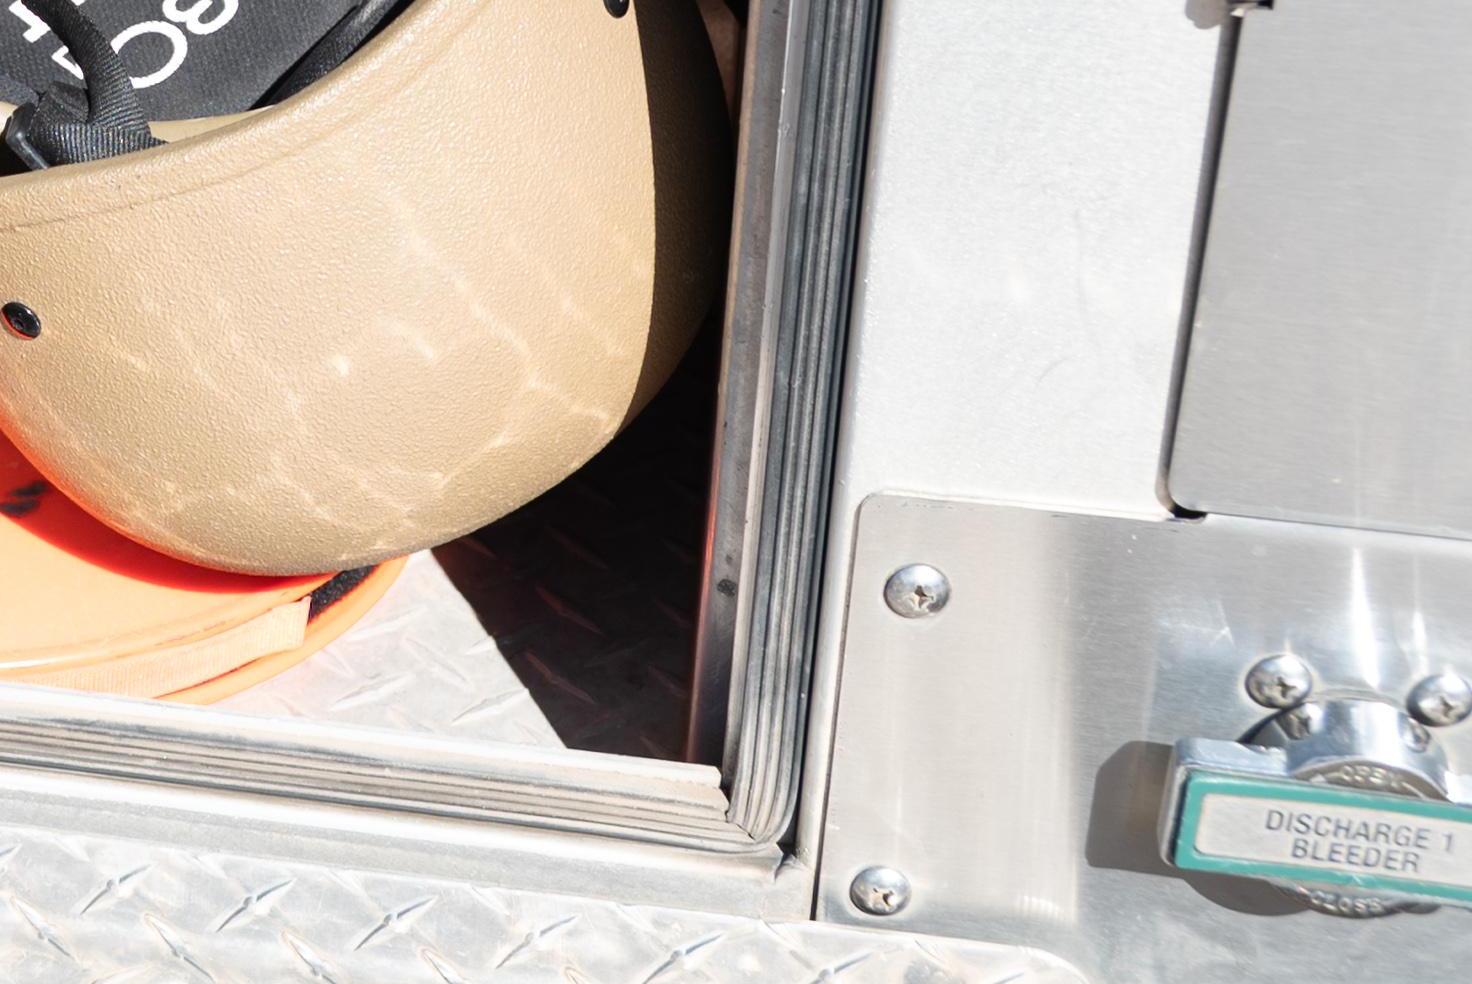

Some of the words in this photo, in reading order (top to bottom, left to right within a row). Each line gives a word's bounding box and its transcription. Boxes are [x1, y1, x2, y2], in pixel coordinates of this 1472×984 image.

[1265, 809, 1431, 850] DISCHARGE
[1443, 832, 1455, 853] 1
[1290, 837, 1421, 874] BLEEDER
